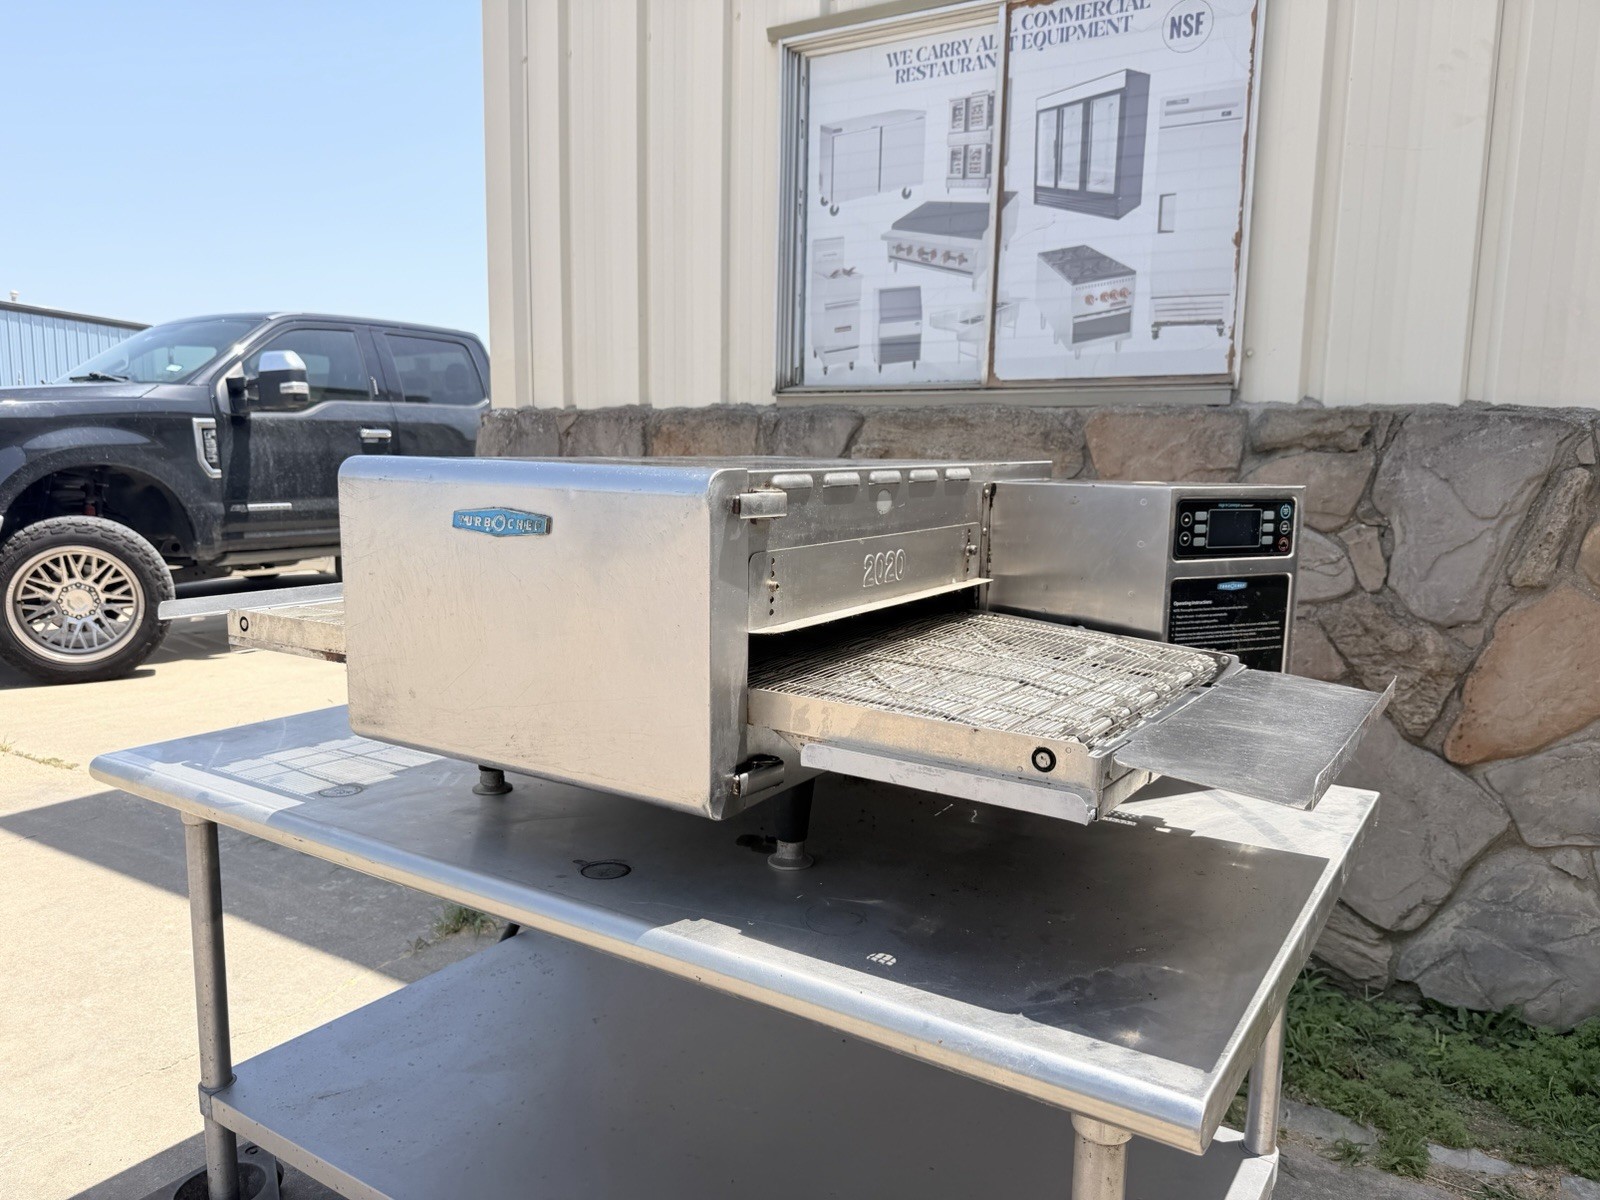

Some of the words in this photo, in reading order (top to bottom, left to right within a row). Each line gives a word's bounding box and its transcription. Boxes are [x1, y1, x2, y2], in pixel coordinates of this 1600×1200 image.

[886, 49, 913, 68] WE
[916, 38, 973, 62] CARRY
[1021, 0, 1151, 31] COMMERCIAL
[1021, 15, 1134, 51] EQUIPMENT
[1169, 11, 1205, 40] NSF
[863, 548, 906, 588] 2020
